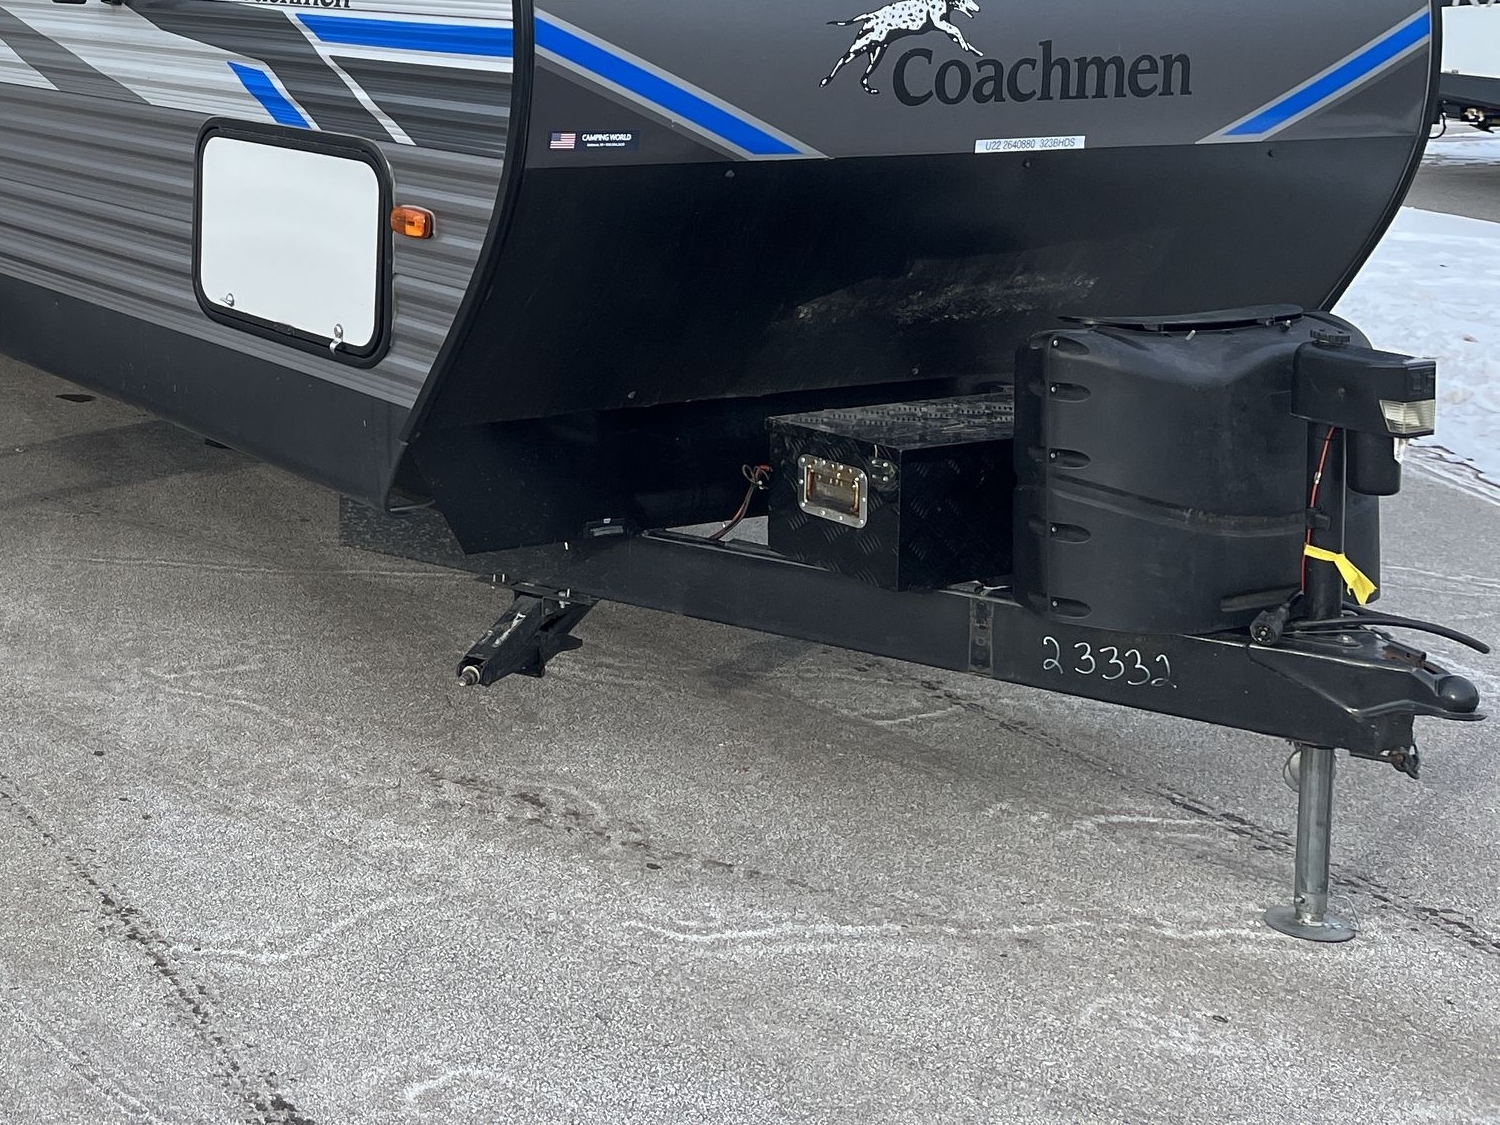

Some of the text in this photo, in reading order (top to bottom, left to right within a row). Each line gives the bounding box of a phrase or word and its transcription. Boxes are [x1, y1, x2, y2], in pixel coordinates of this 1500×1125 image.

[891, 38, 1194, 108] Coachmen
[582, 133, 633, 142] CAMPING WORLD
[986, 141, 1002, 150] U22
[1042, 635, 1178, 689] 23332
